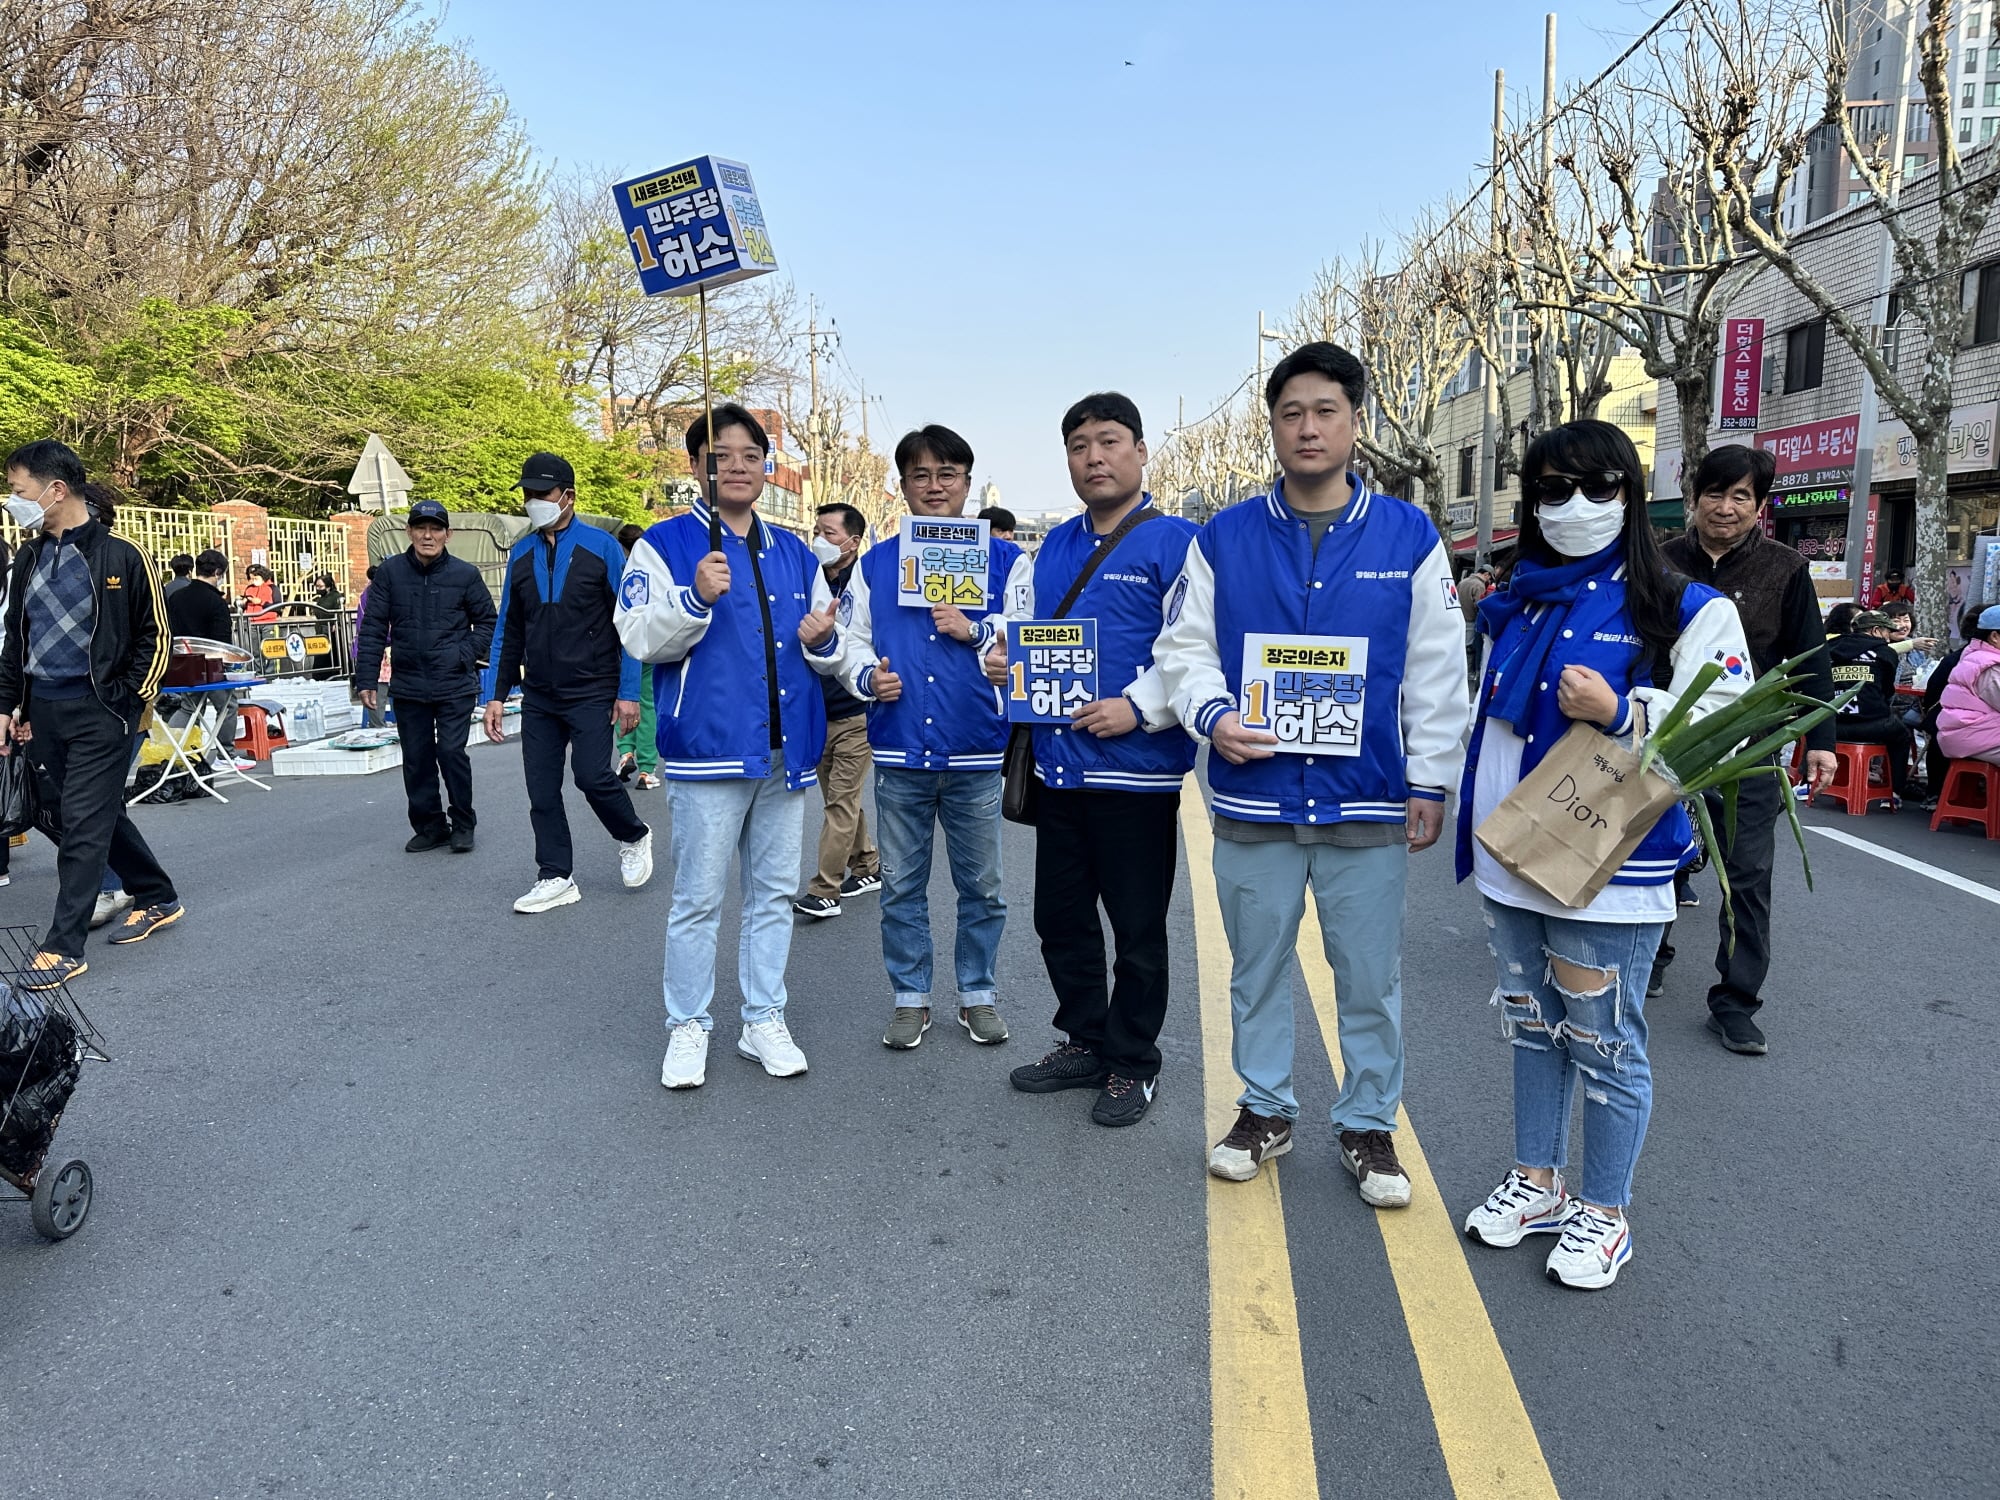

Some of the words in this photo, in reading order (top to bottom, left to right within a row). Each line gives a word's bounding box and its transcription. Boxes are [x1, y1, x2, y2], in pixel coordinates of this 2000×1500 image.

[633, 169, 697, 203] 새로운선택
[646, 187, 720, 235] 민주당
[727, 204, 748, 253] 1
[732, 194, 765, 227] 유능한
[629, 225, 659, 272] 1
[658, 225, 735, 278] 허소
[743, 226, 776, 265] 허소
[1735, 323, 1754, 363] 더힐스
[1732, 368, 1751, 411] 부동산
[1722, 417, 1756, 427] 352-8878
[1948, 419, 1992, 459] 과일
[1779, 434, 1813, 463] 더힐스
[1817, 425, 1856, 457] 부동산
[915, 525, 978, 541] 새로운선택
[1798, 538, 1846, 555] 352-887
[1864, 510, 1876, 553] 더힐스
[901, 555, 921, 594] 1
[922, 546, 988, 573] 유능한
[924, 573, 983, 605] 허소
[1861, 561, 1872, 609] 부동산
[1023, 628, 1080, 642] 장군의손자
[1029, 648, 1095, 674] 민주당
[1266, 648, 1346, 666] 장군의손자
[1010, 661, 1028, 700] 1
[1030, 678, 1094, 717] 허소
[1274, 670, 1366, 705] 민주당
[1241, 678, 1271, 729] 1
[1274, 700, 1358, 745] 허소
[1547, 774, 1607, 829] Dior
